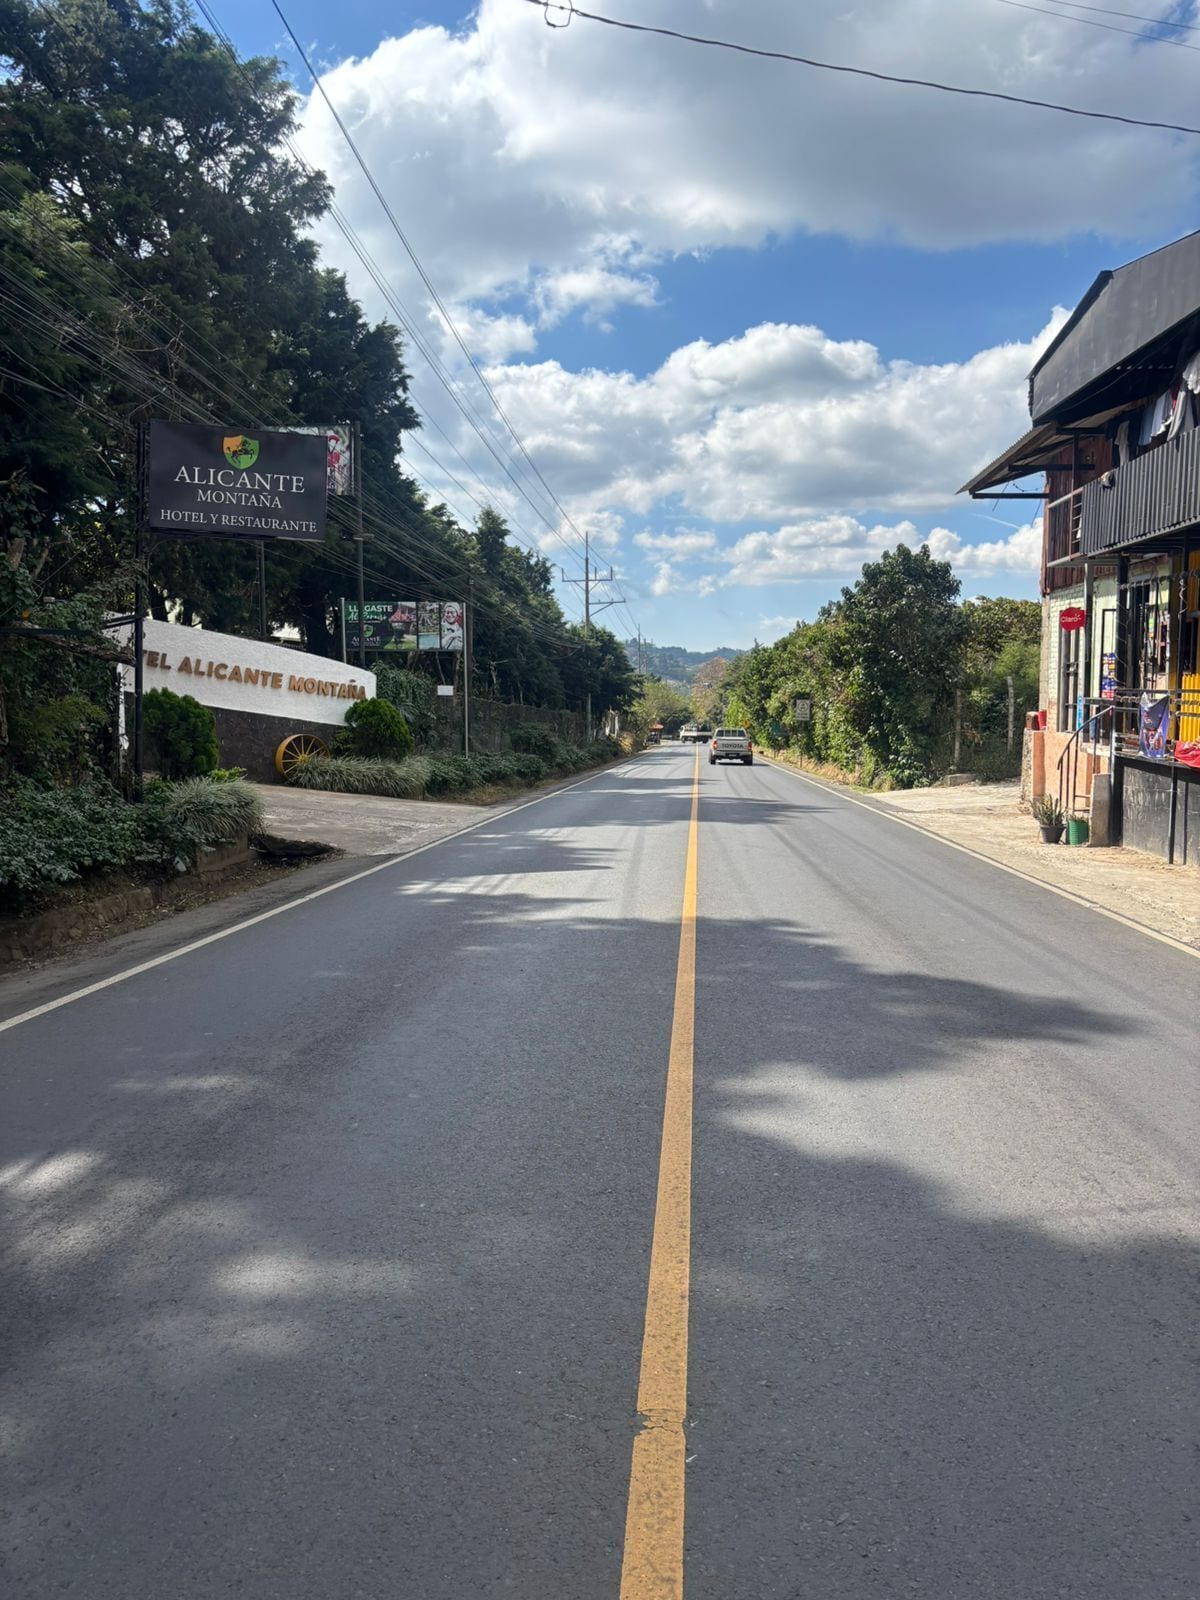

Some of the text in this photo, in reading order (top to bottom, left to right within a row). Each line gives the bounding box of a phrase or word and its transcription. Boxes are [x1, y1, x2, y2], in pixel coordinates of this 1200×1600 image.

[173, 465, 306, 493] ALICANTE
[197, 489, 283, 509] MONTAÑA
[160, 509, 318, 533] HOTEL Y RESTAURANTE
[348, 604, 393, 612] LLGASTE
[1060, 615, 1079, 623] Claro
[178, 656, 283, 688] ALICANTE
[288, 675, 367, 700] MONTAÑA
